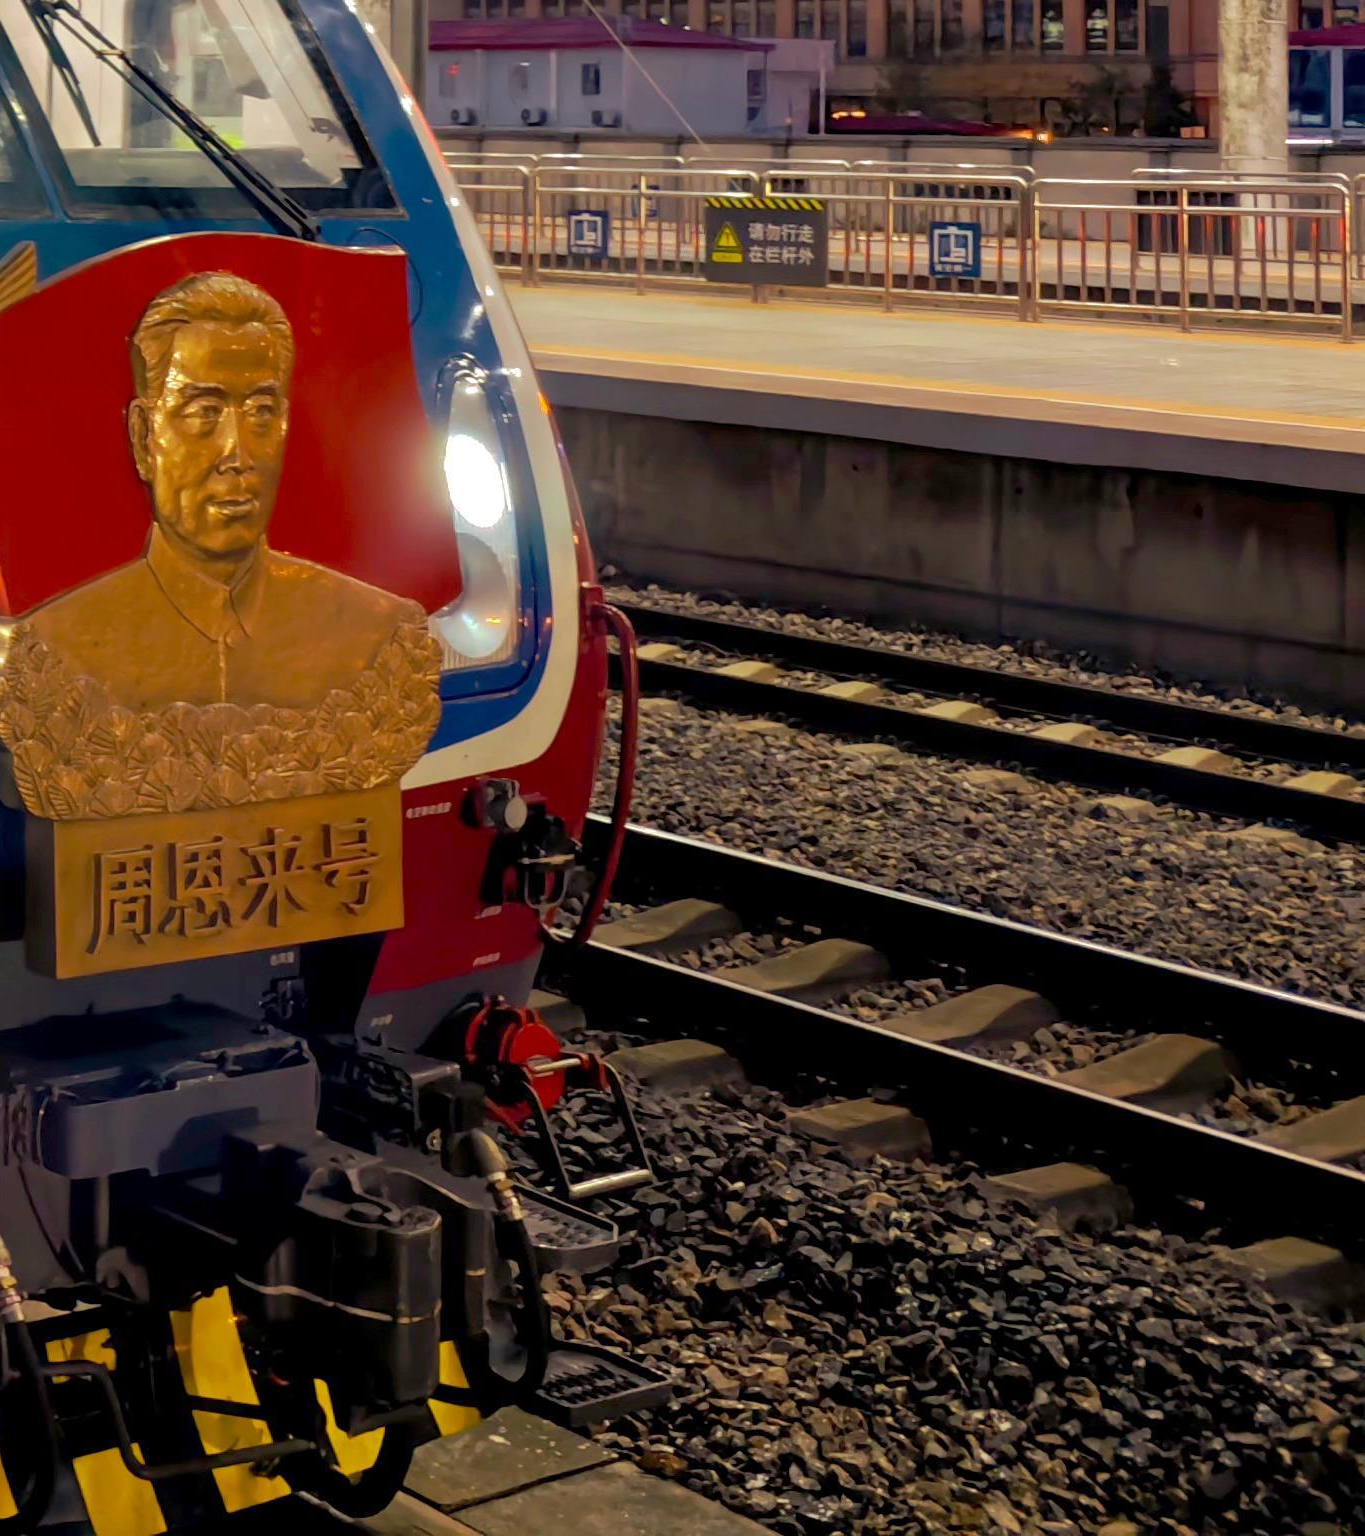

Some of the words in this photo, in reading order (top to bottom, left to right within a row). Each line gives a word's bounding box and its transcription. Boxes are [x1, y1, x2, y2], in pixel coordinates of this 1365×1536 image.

[747, 222, 814, 244] 请勿行走
[748, 244, 815, 266] 在栏杆外
[84, 816, 379, 956] 周恩来号
